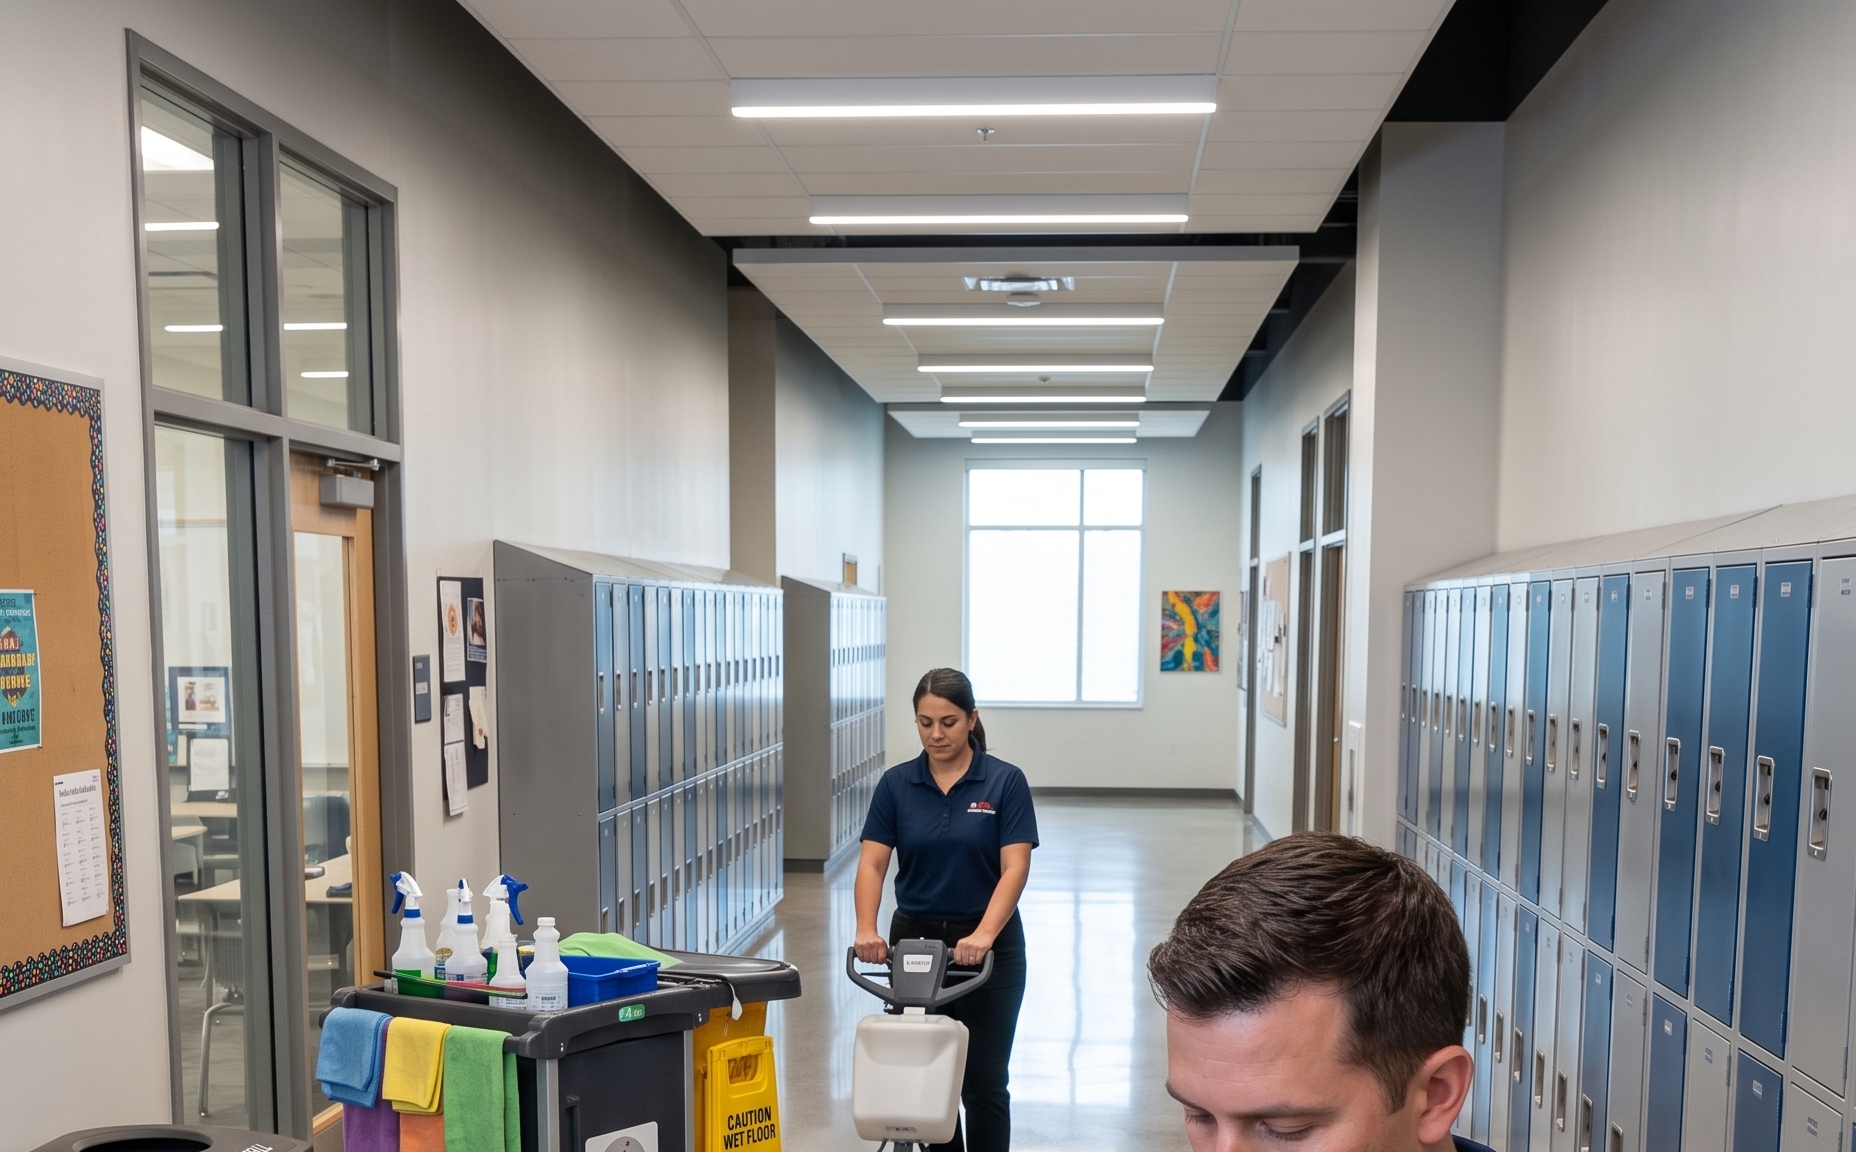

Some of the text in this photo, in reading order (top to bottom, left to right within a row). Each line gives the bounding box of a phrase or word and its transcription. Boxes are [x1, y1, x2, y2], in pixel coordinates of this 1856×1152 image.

[727, 1106, 771, 1131] CAUTION
[723, 1123, 776, 1150] WET FLOOR
